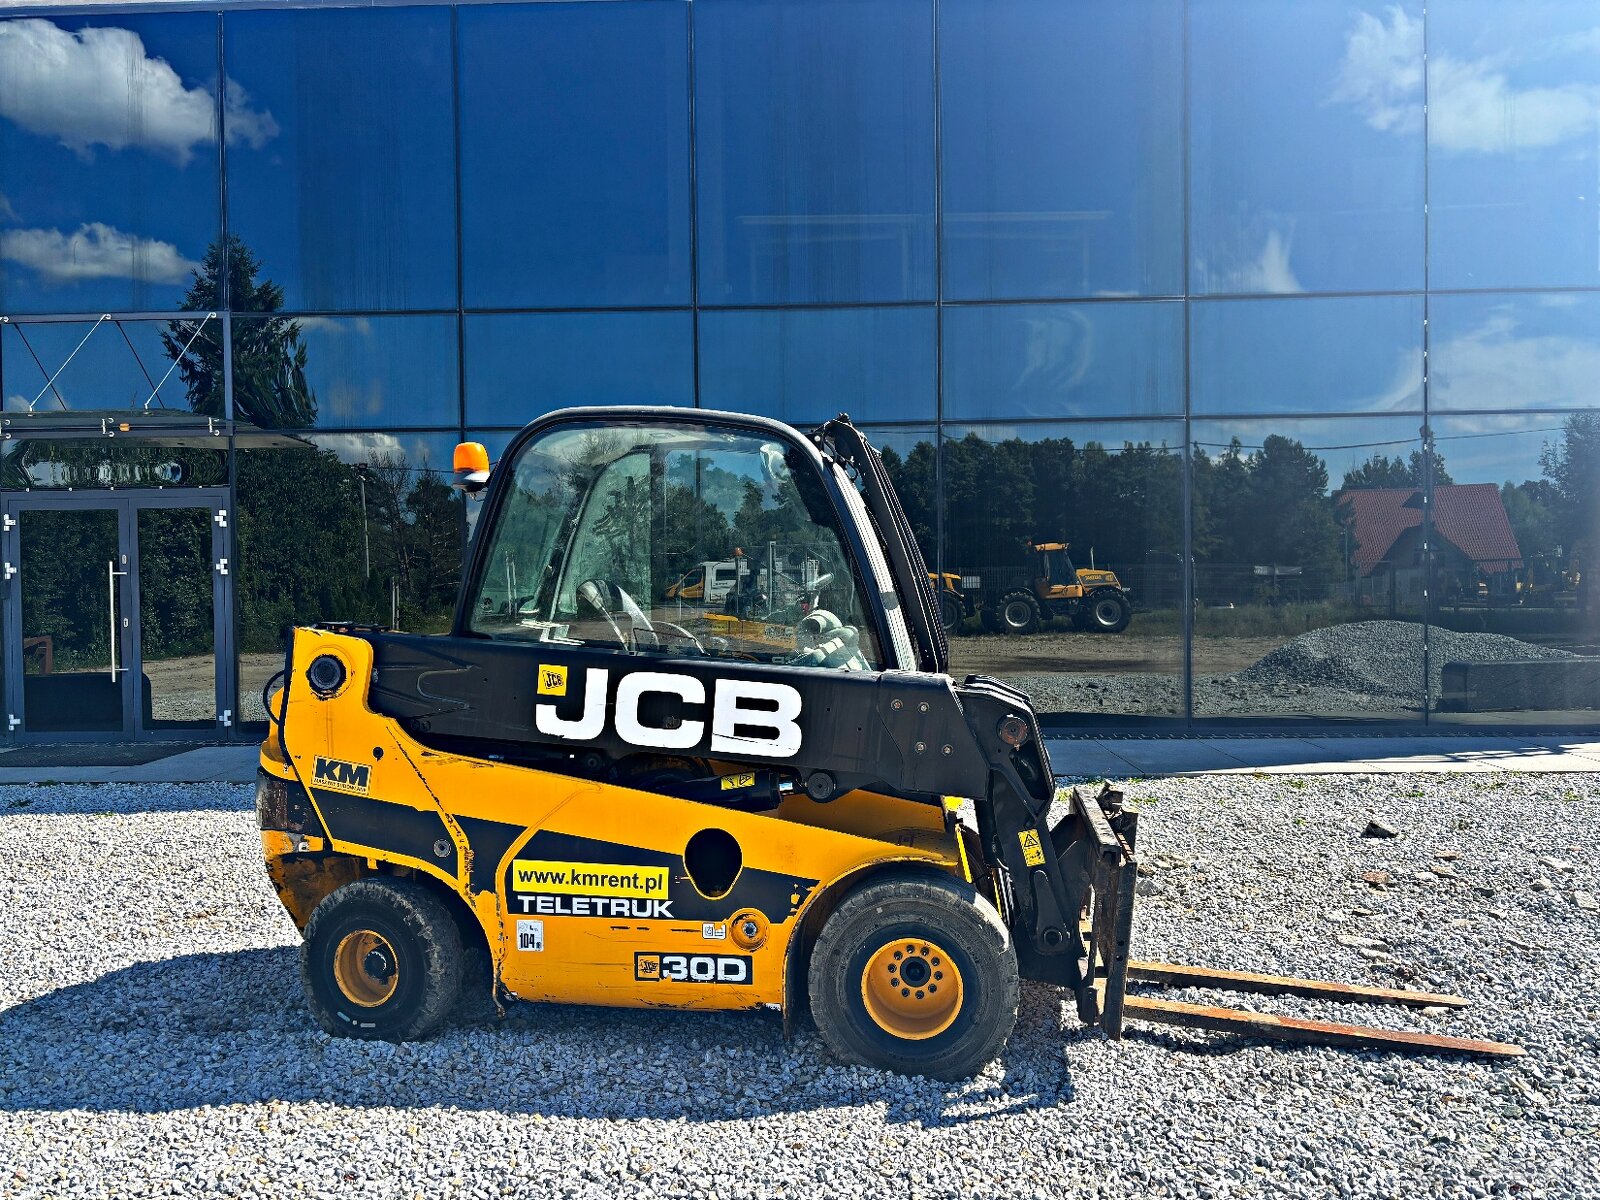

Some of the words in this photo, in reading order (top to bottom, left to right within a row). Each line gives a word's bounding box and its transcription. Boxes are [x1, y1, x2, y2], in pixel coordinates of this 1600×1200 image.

[546, 672, 564, 687] JCB
[535, 667, 802, 758] JCB
[315, 758, 369, 788] KM
[518, 869, 663, 894] www.kmrent.pl
[517, 895, 674, 918] TELETRUK
[519, 932, 535, 948] 104
[662, 955, 747, 982] 30D
